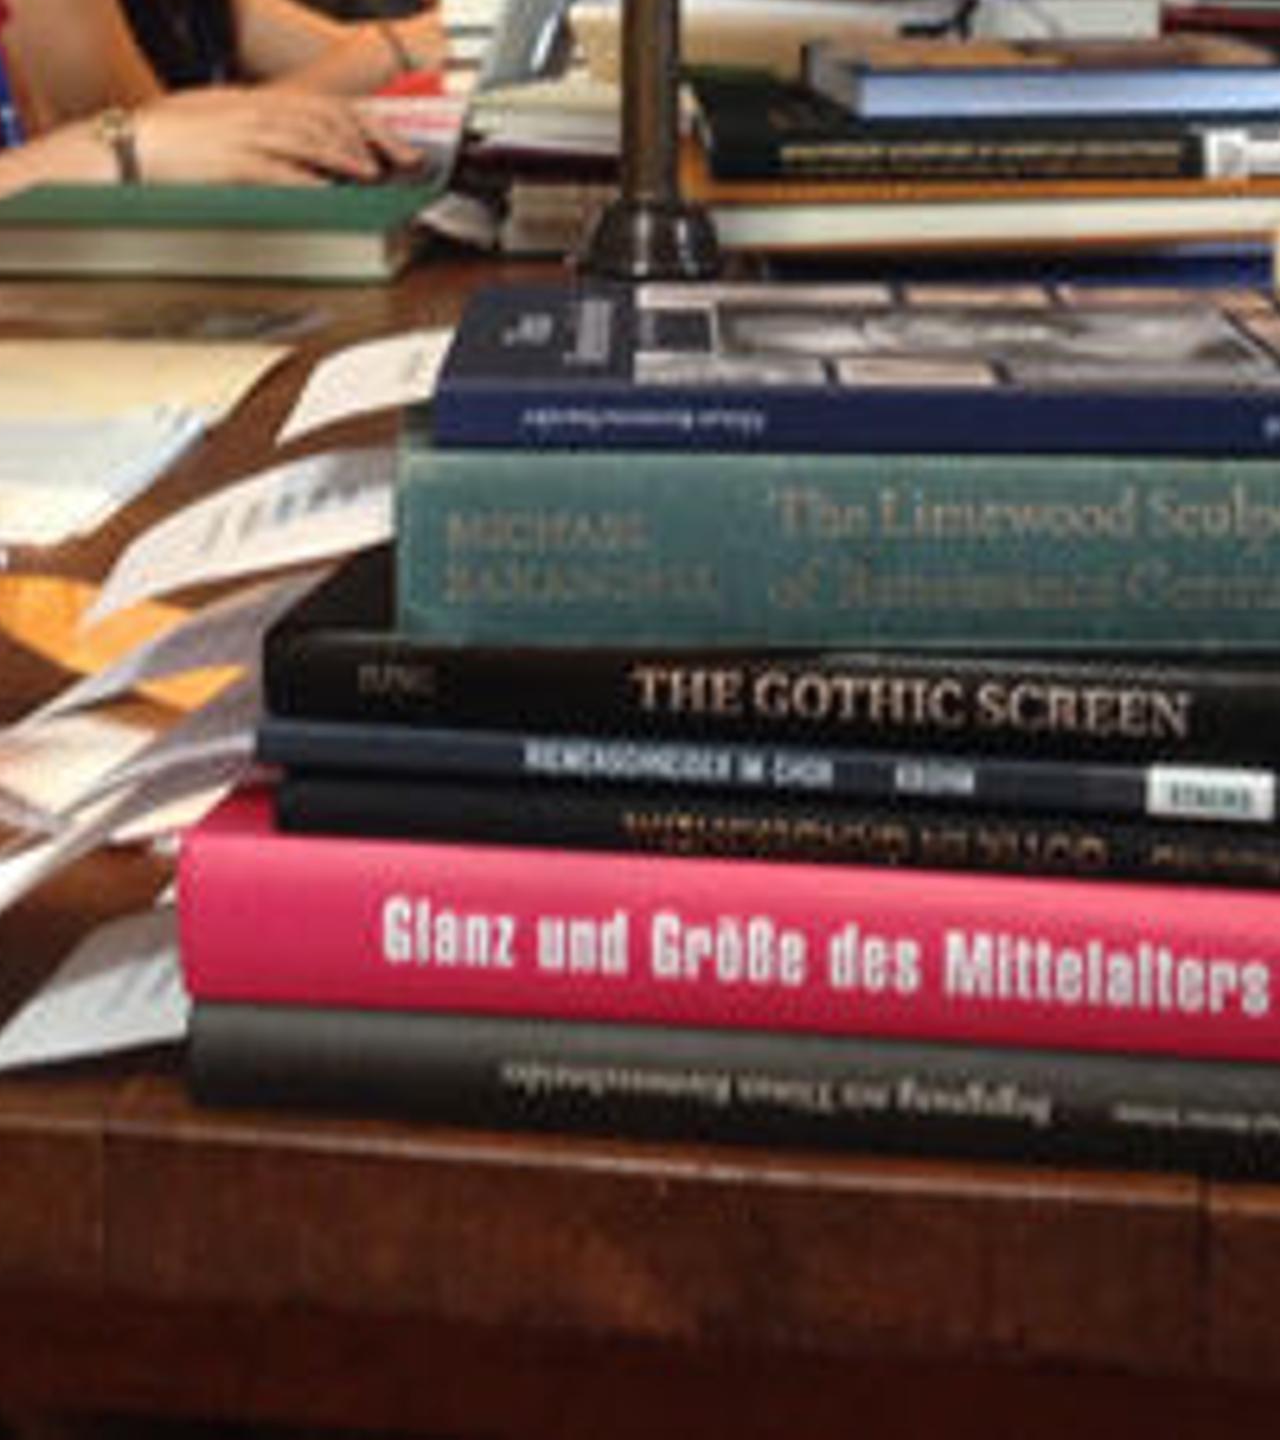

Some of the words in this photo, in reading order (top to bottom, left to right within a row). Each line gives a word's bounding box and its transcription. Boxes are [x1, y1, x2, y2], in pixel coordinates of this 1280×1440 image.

[769, 489, 869, 538] The
[629, 665, 740, 713] THE
[752, 670, 965, 727] GOTHIC
[975, 680, 1191, 737] SCREEN
[382, 897, 516, 969] Glanz
[535, 907, 629, 976] und
[650, 910, 808, 987] Größe
[827, 921, 922, 996] des
[943, 928, 1271, 1019] Mittelalters
